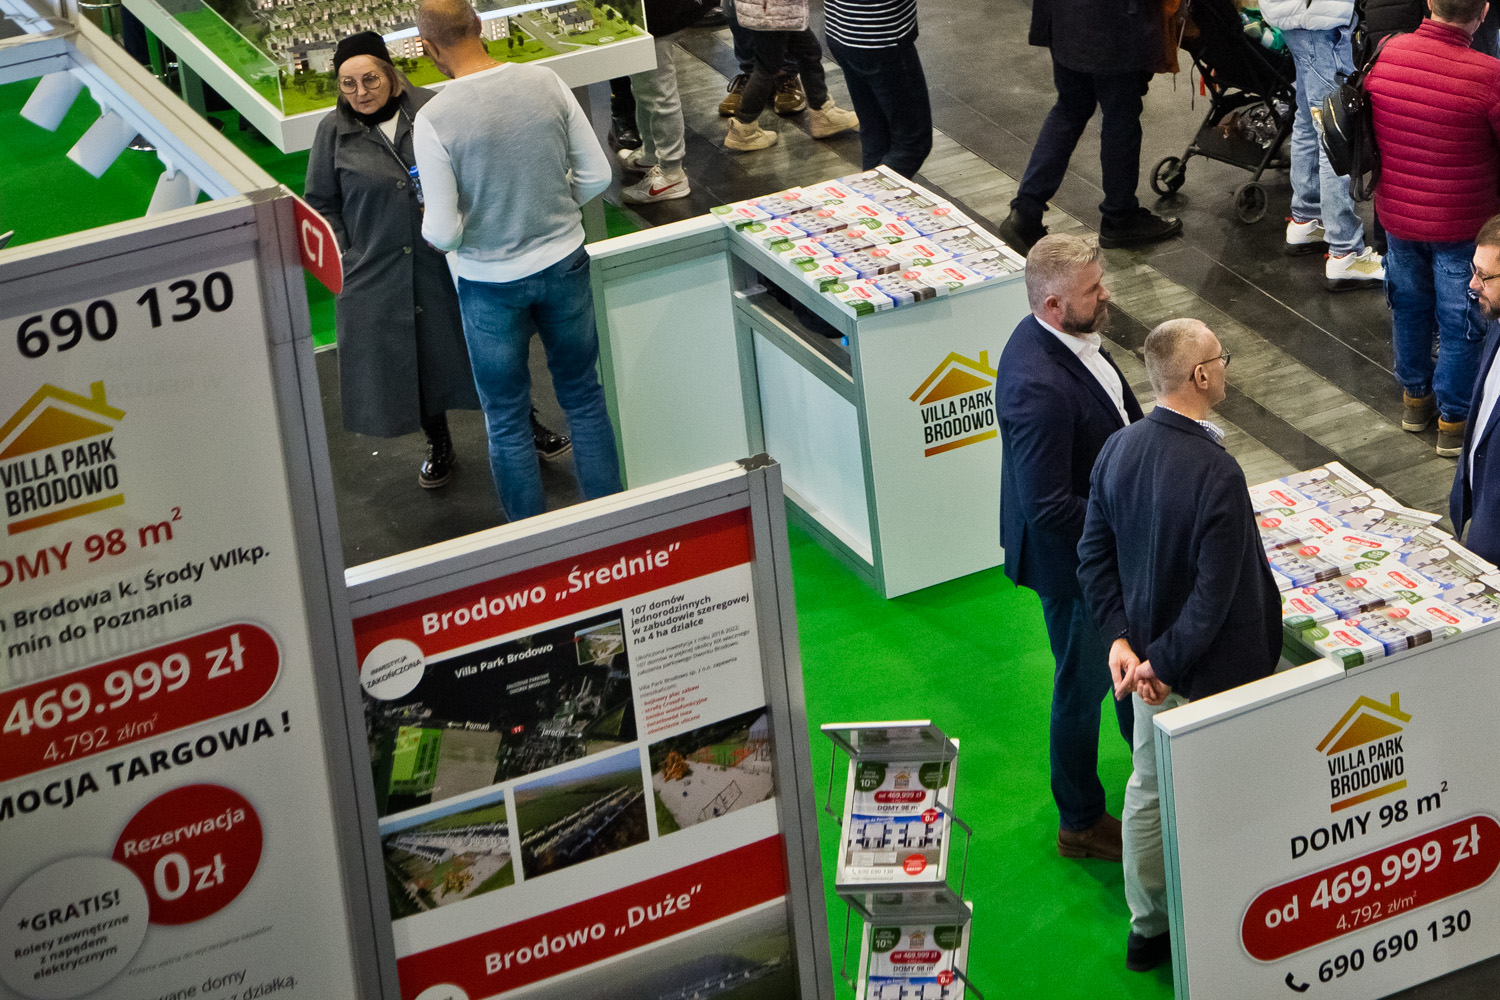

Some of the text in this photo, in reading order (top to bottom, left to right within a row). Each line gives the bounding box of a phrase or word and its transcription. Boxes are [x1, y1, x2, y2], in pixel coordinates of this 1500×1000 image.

[301, 218, 325, 268] C7
[16, 271, 234, 359] 690 130
[921, 389, 993, 425] VILLA PARK
[924, 408, 994, 444] BRODOWO
[0, 437, 116, 488] VILLA PARK
[5, 464, 119, 517] BRODOWO
[84, 528, 127, 562] 98
[14, 545, 270, 629] Brodowa k. Środy Wlkp.
[631, 594, 685, 616] 107 domów
[8, 591, 193, 658] min do Poznania
[422, 582, 547, 636] Brodowo
[631, 595, 711, 628] jednorodzinnych
[643, 592, 750, 633] zabudowie szeregowej
[633, 618, 704, 645] na 4 ha działce
[365, 658, 422, 689] ZAKOŃCZONA
[455, 643, 553, 679] Villa Park Brodowo
[3, 632, 247, 737] 469.999 zł
[42, 727, 109, 763] 4.792
[105, 717, 274, 786] TARGOWA
[1328, 735, 1404, 777] VILLA PARK
[1330, 755, 1404, 798] BRODOWO
[123, 807, 246, 858] Rezerwacja
[1290, 811, 1371, 859] DOMY
[1379, 800, 1408, 828] 98
[1265, 824, 1481, 929] od 469.999 zł
[14, 915, 129, 960] Rolety zewnętrzne
[1336, 902, 1383, 930] 4.792
[33, 944, 118, 981] elektrycznym
[49, 935, 108, 962] napędem
[485, 922, 606, 976] Brodowo
[1318, 910, 1471, 982] 690 690 130
[202, 969, 246, 994] domy
